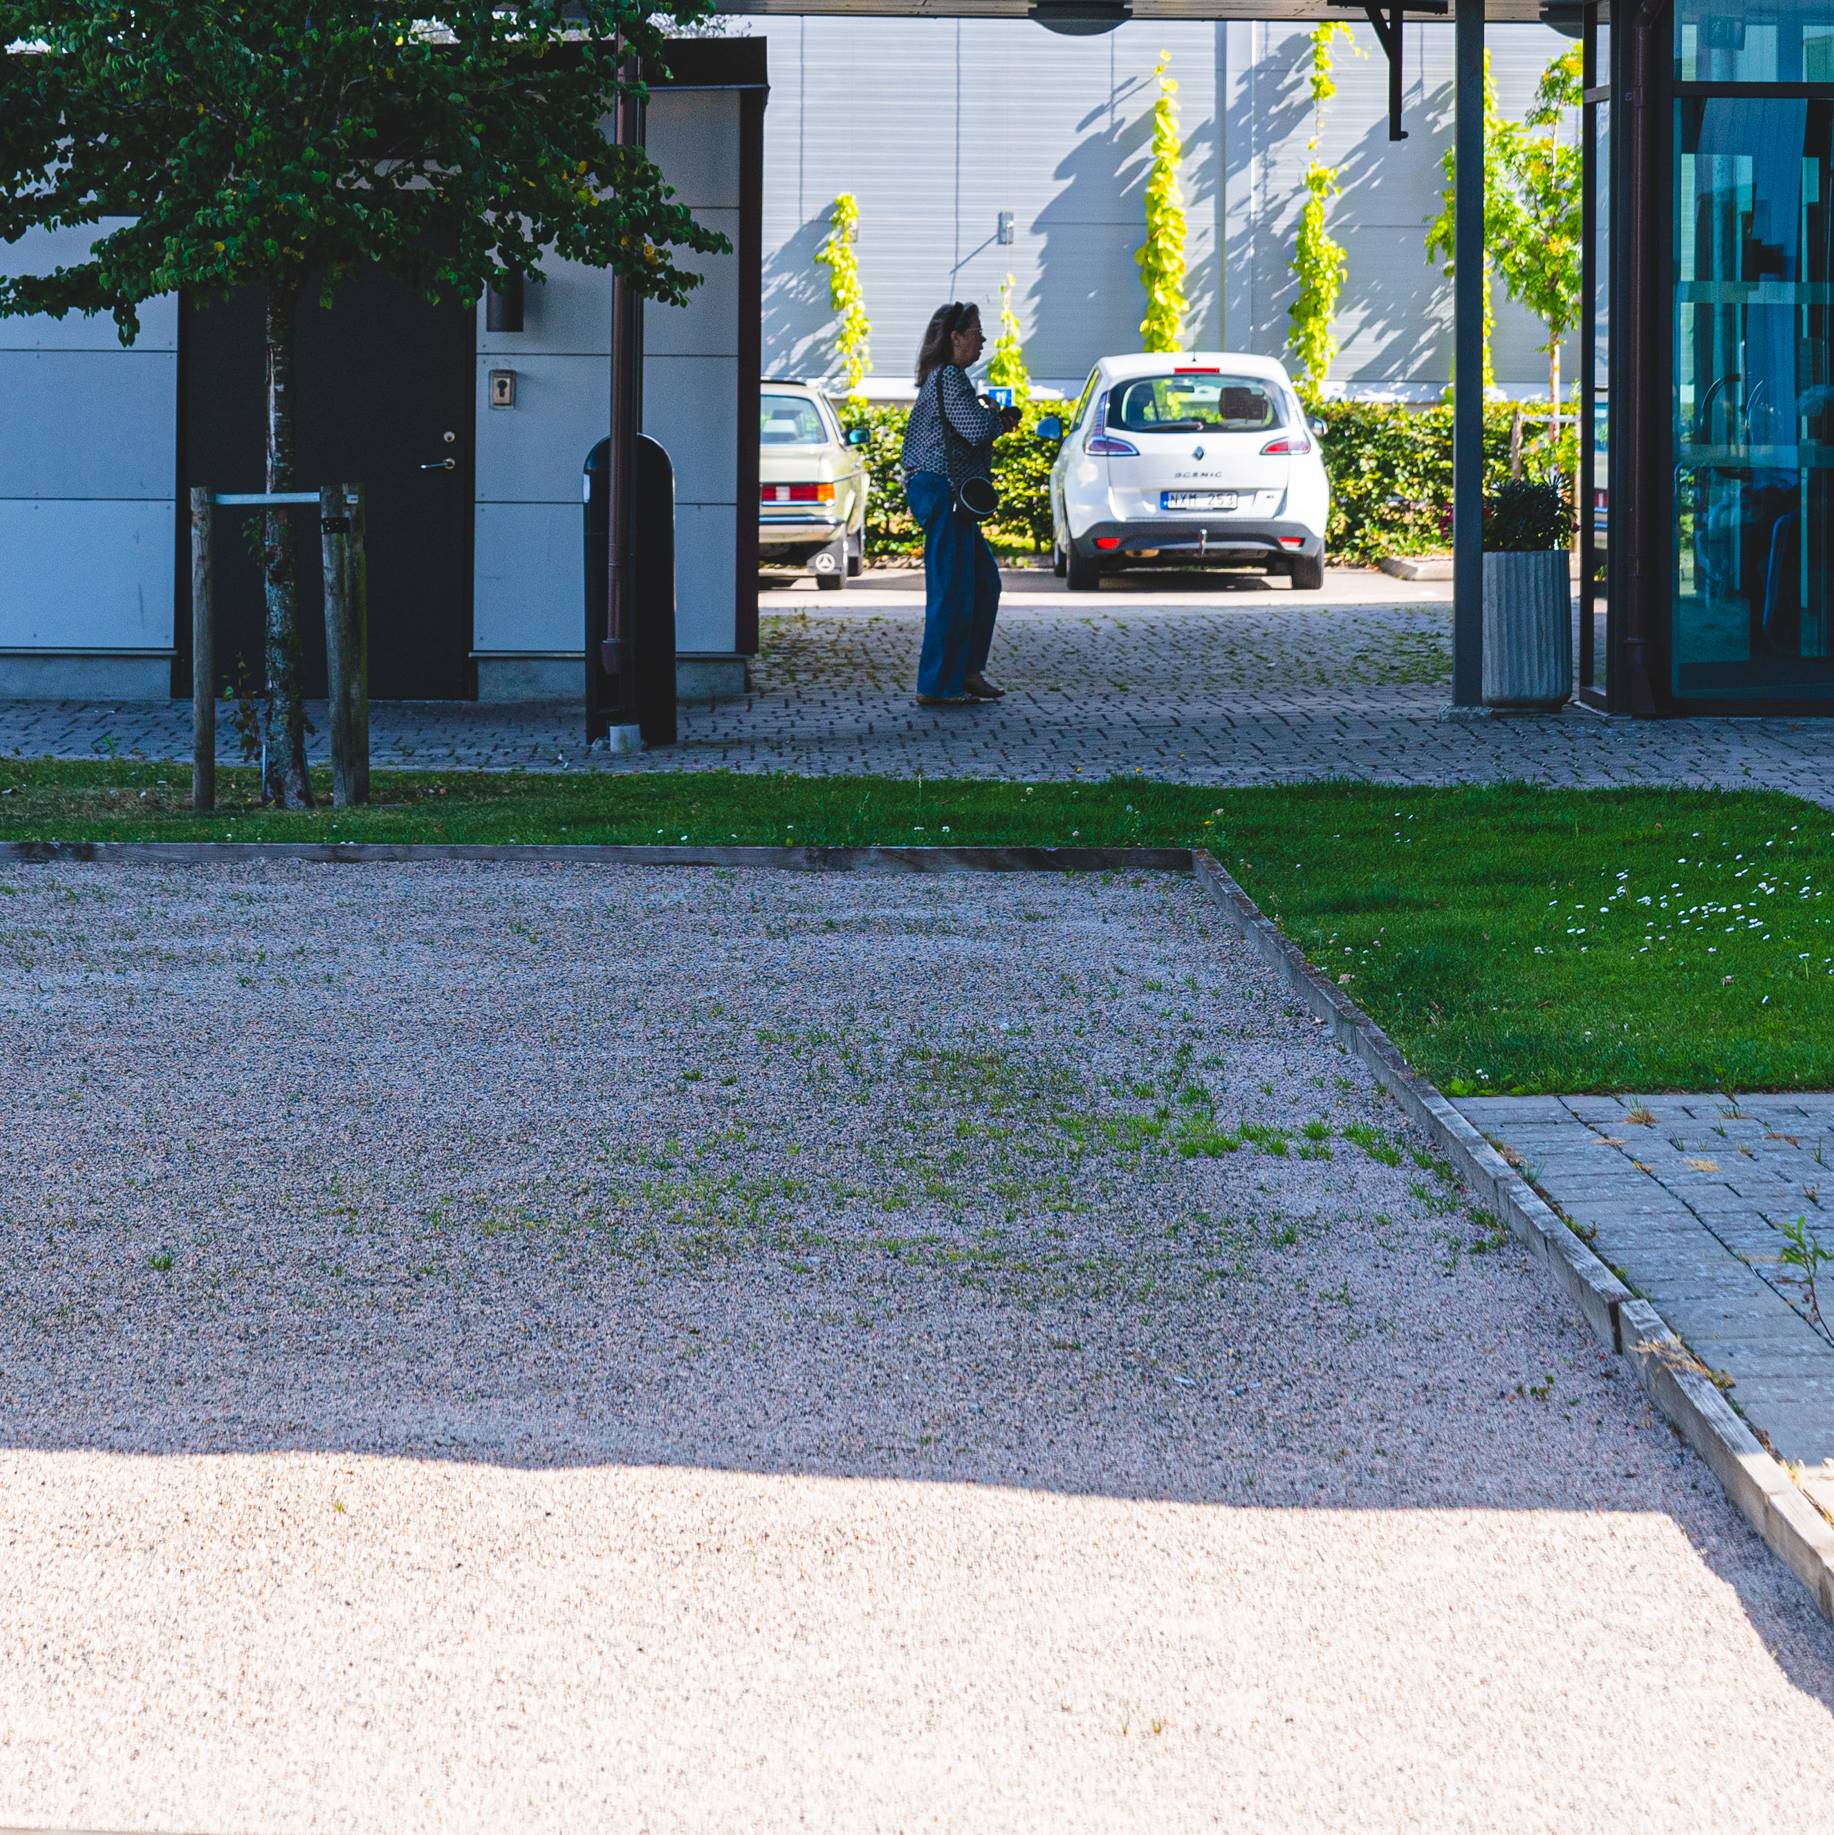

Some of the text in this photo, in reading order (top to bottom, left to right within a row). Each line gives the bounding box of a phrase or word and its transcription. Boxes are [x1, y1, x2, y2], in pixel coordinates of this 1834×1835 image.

[1174, 471, 1223, 479] SCENIC
[1170, 493, 1234, 506] NXM 253
